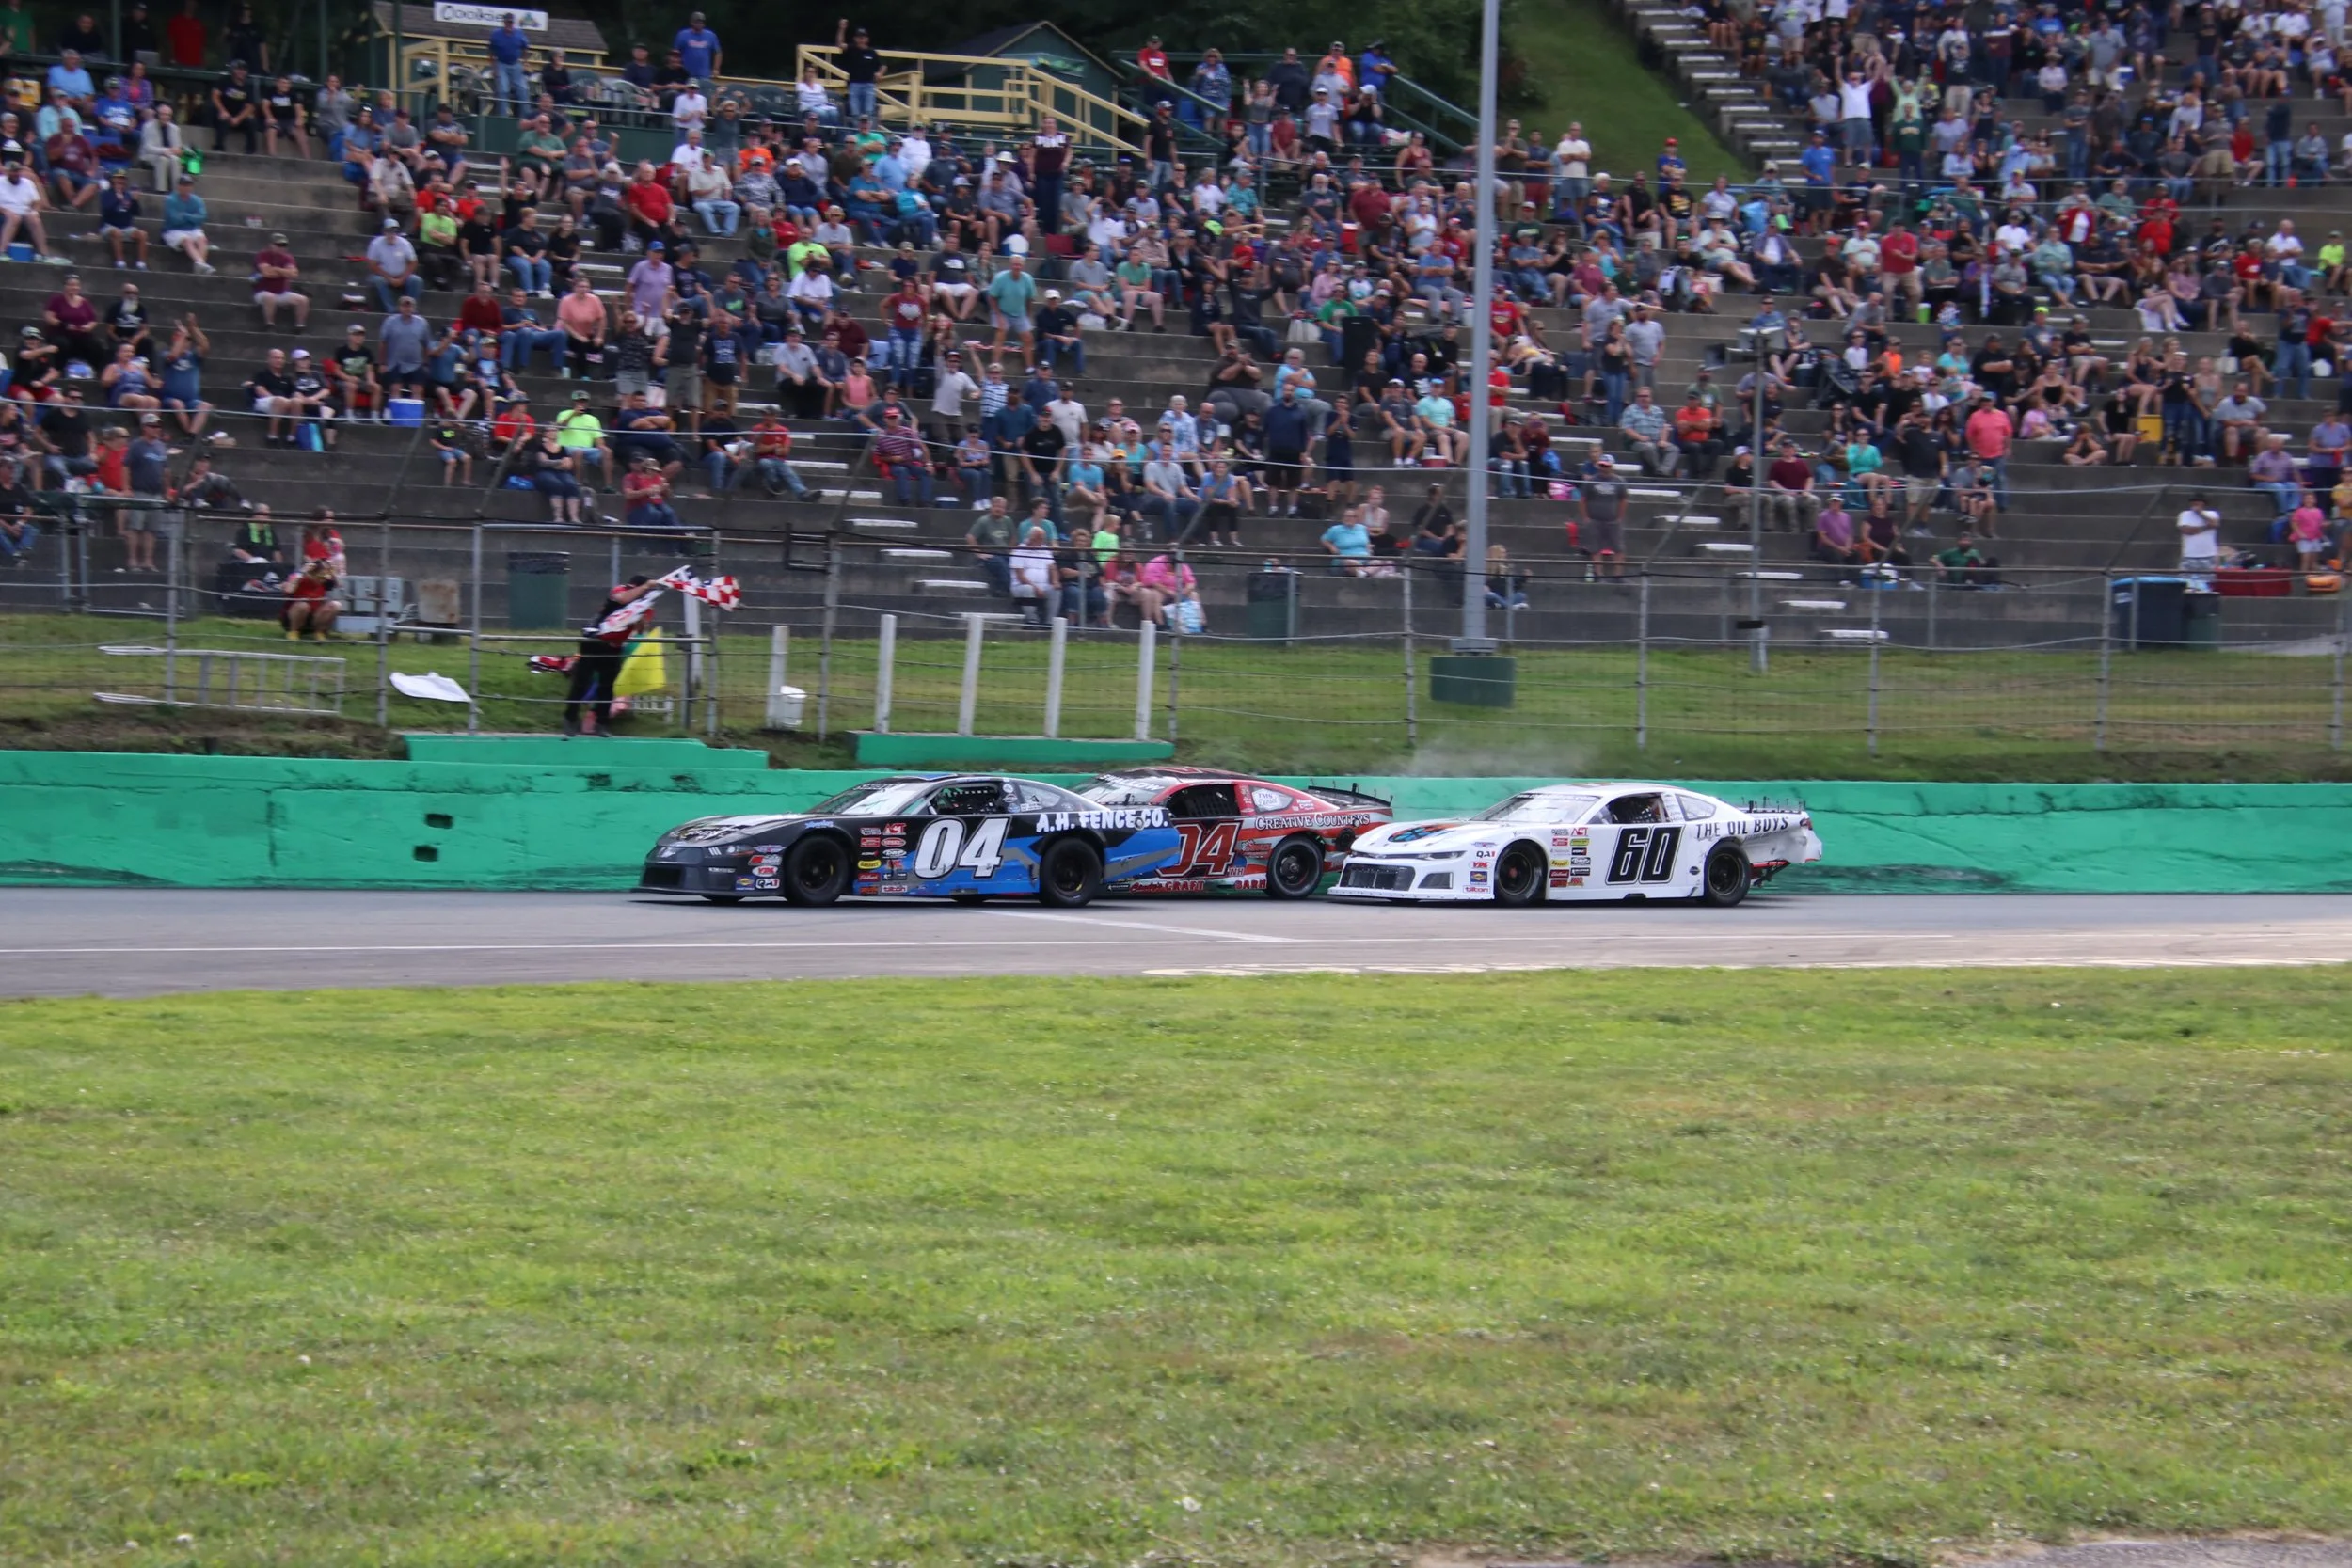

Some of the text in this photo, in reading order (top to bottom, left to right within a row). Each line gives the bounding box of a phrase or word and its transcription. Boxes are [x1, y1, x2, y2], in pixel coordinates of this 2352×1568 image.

[1036, 808, 1168, 832] A.H. FENCE CO.
[1696, 822, 1720, 839] THE
[1727, 820, 1748, 835] OIL
[1570, 827, 1588, 836] ACT
[914, 817, 1010, 879] 04
[1606, 826, 1685, 885] 60
[757, 879, 778, 888] QA1
[1167, 879, 1204, 892] CRAFT
[1234, 879, 1267, 890] BARN
